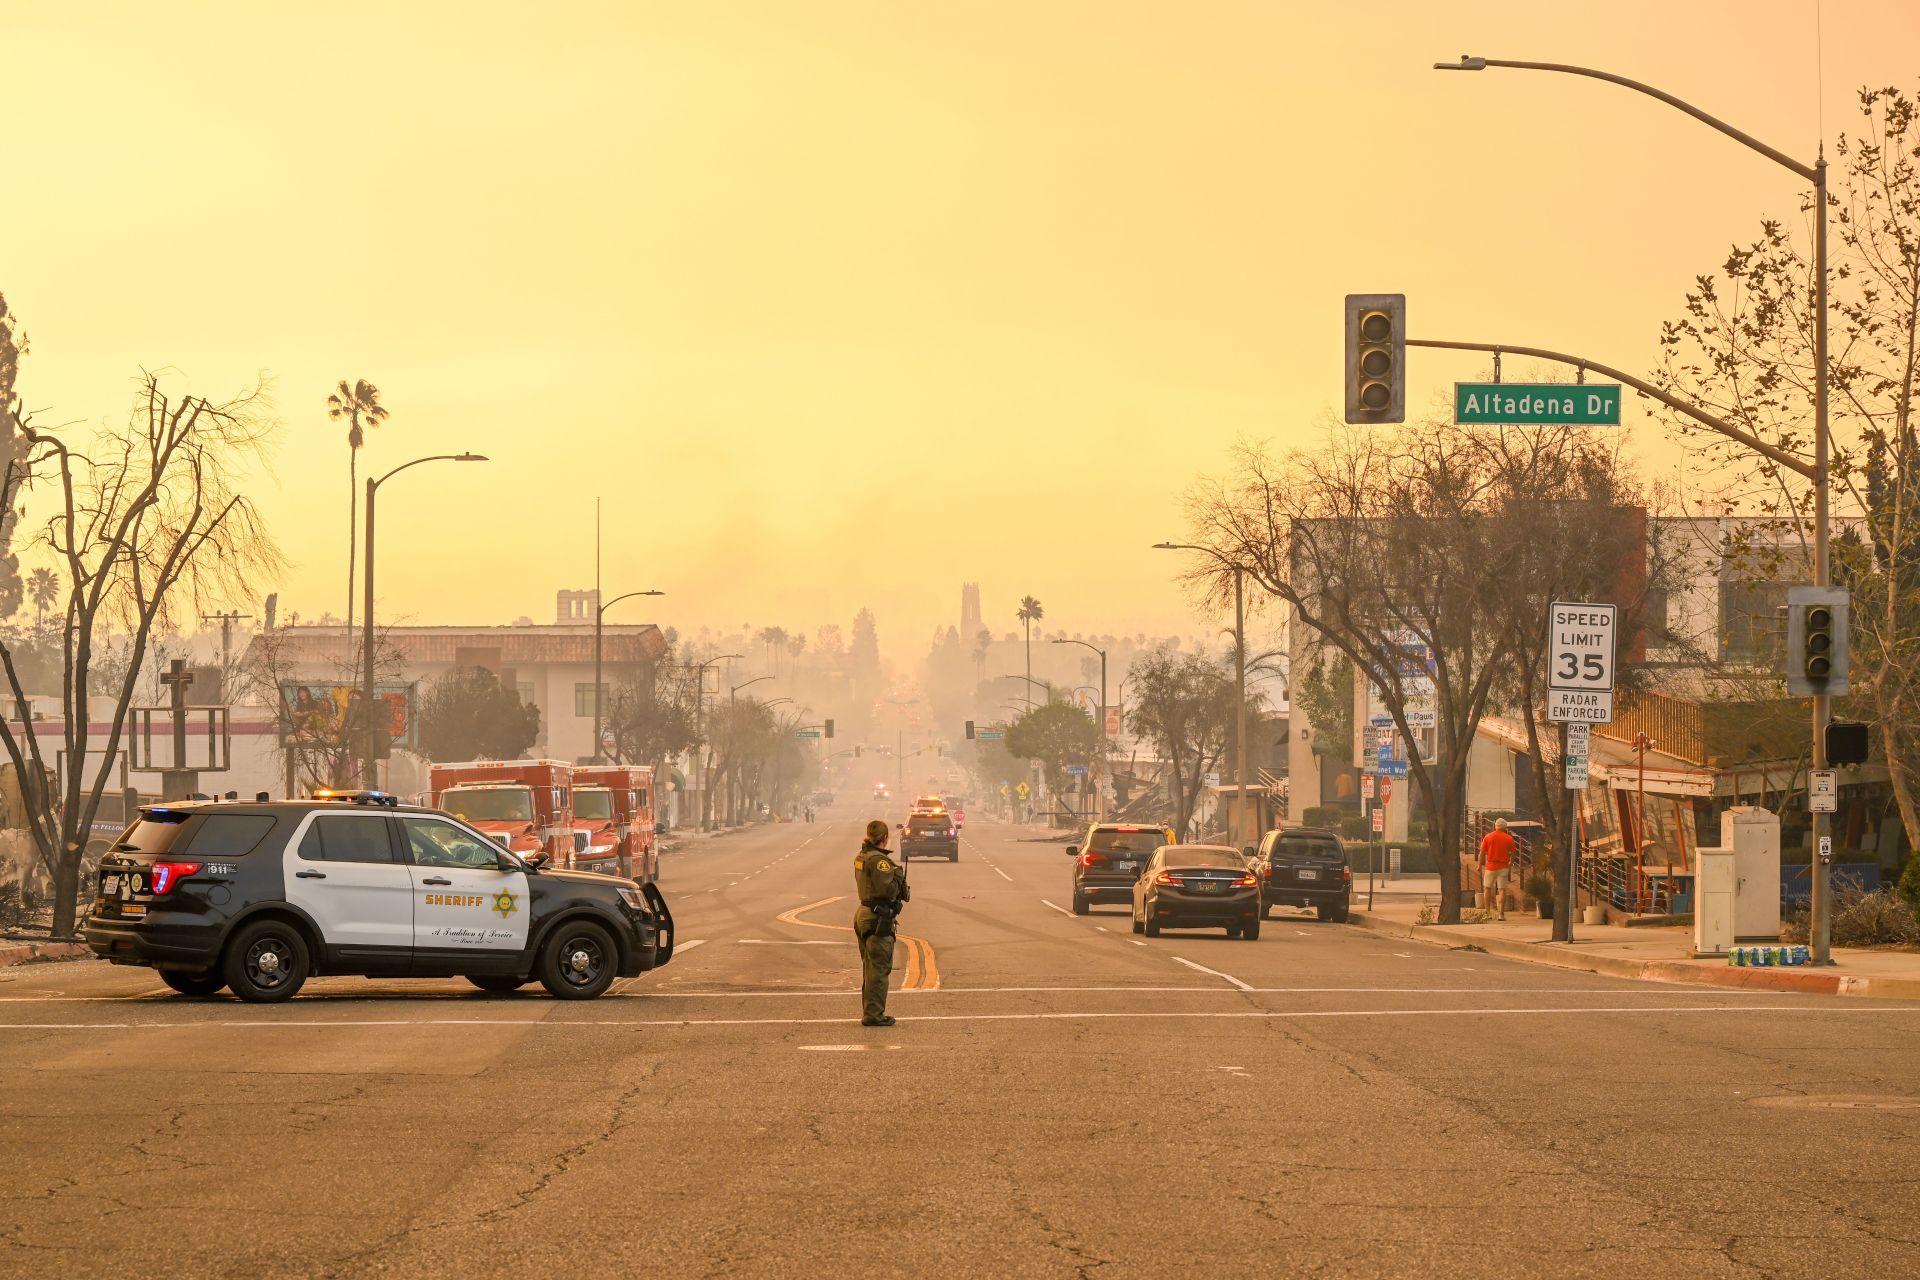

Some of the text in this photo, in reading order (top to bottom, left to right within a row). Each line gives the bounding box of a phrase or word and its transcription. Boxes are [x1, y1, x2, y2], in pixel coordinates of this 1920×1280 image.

[1464, 393, 1613, 415] Altadena Dr
[1556, 612, 1610, 627] SPEED
[1561, 632, 1603, 647] LIMIT
[1557, 652, 1605, 681] 35
[1562, 694, 1598, 706] RADAR
[1413, 712, 1434, 720] Paws
[1553, 706, 1607, 719] ENFORCED
[1569, 724, 1588, 734] PARK
[1570, 757, 1576, 765] 2
[1395, 767, 1407, 775] Way
[1381, 784, 1391, 796] STOP
[210, 865, 228, 875] 911
[425, 894, 483, 907] SHERIFF
[431, 927, 513, 941] A Tradition of Service
